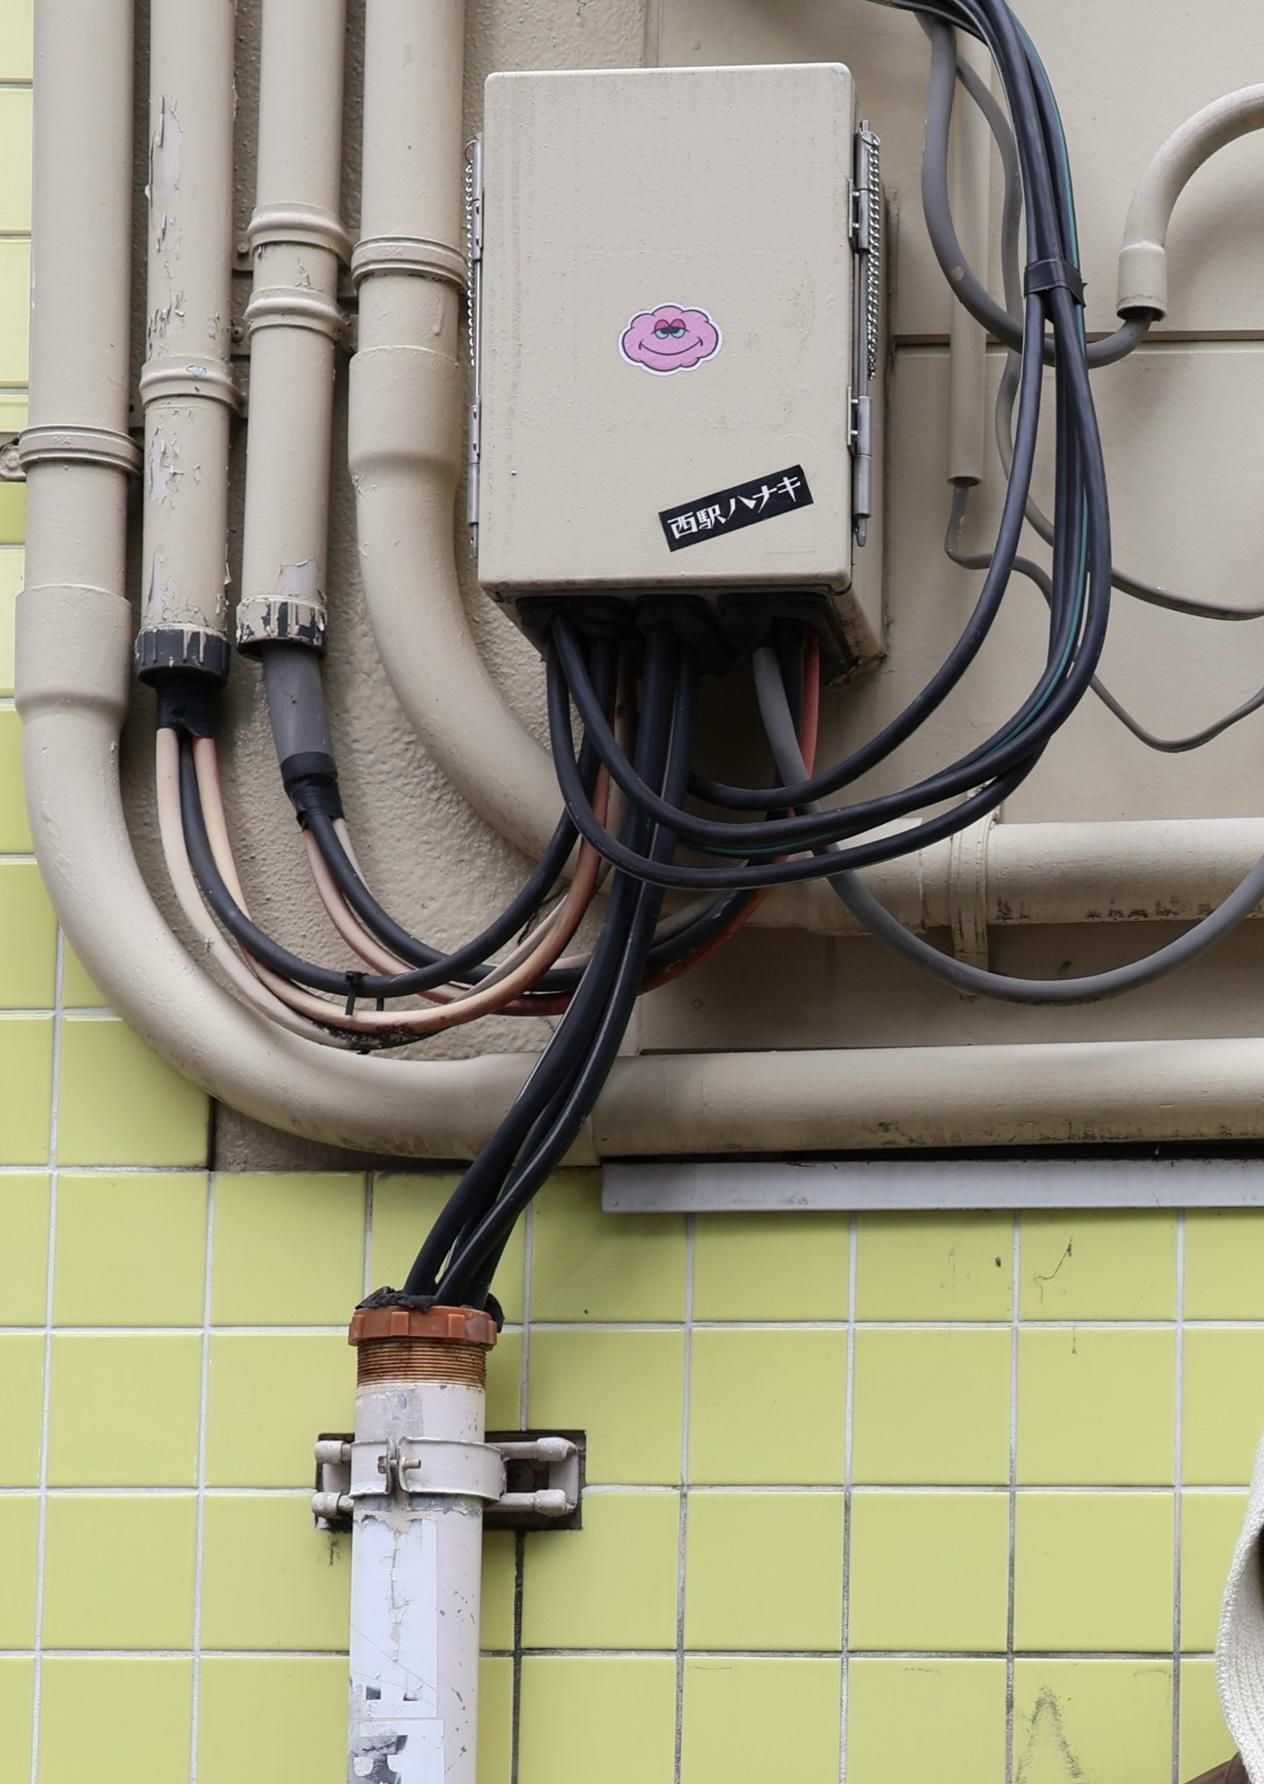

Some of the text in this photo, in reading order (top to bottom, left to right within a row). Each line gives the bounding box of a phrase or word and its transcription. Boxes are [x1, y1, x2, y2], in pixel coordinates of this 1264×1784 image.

[667, 477, 801, 539] 西駅ハナキ
